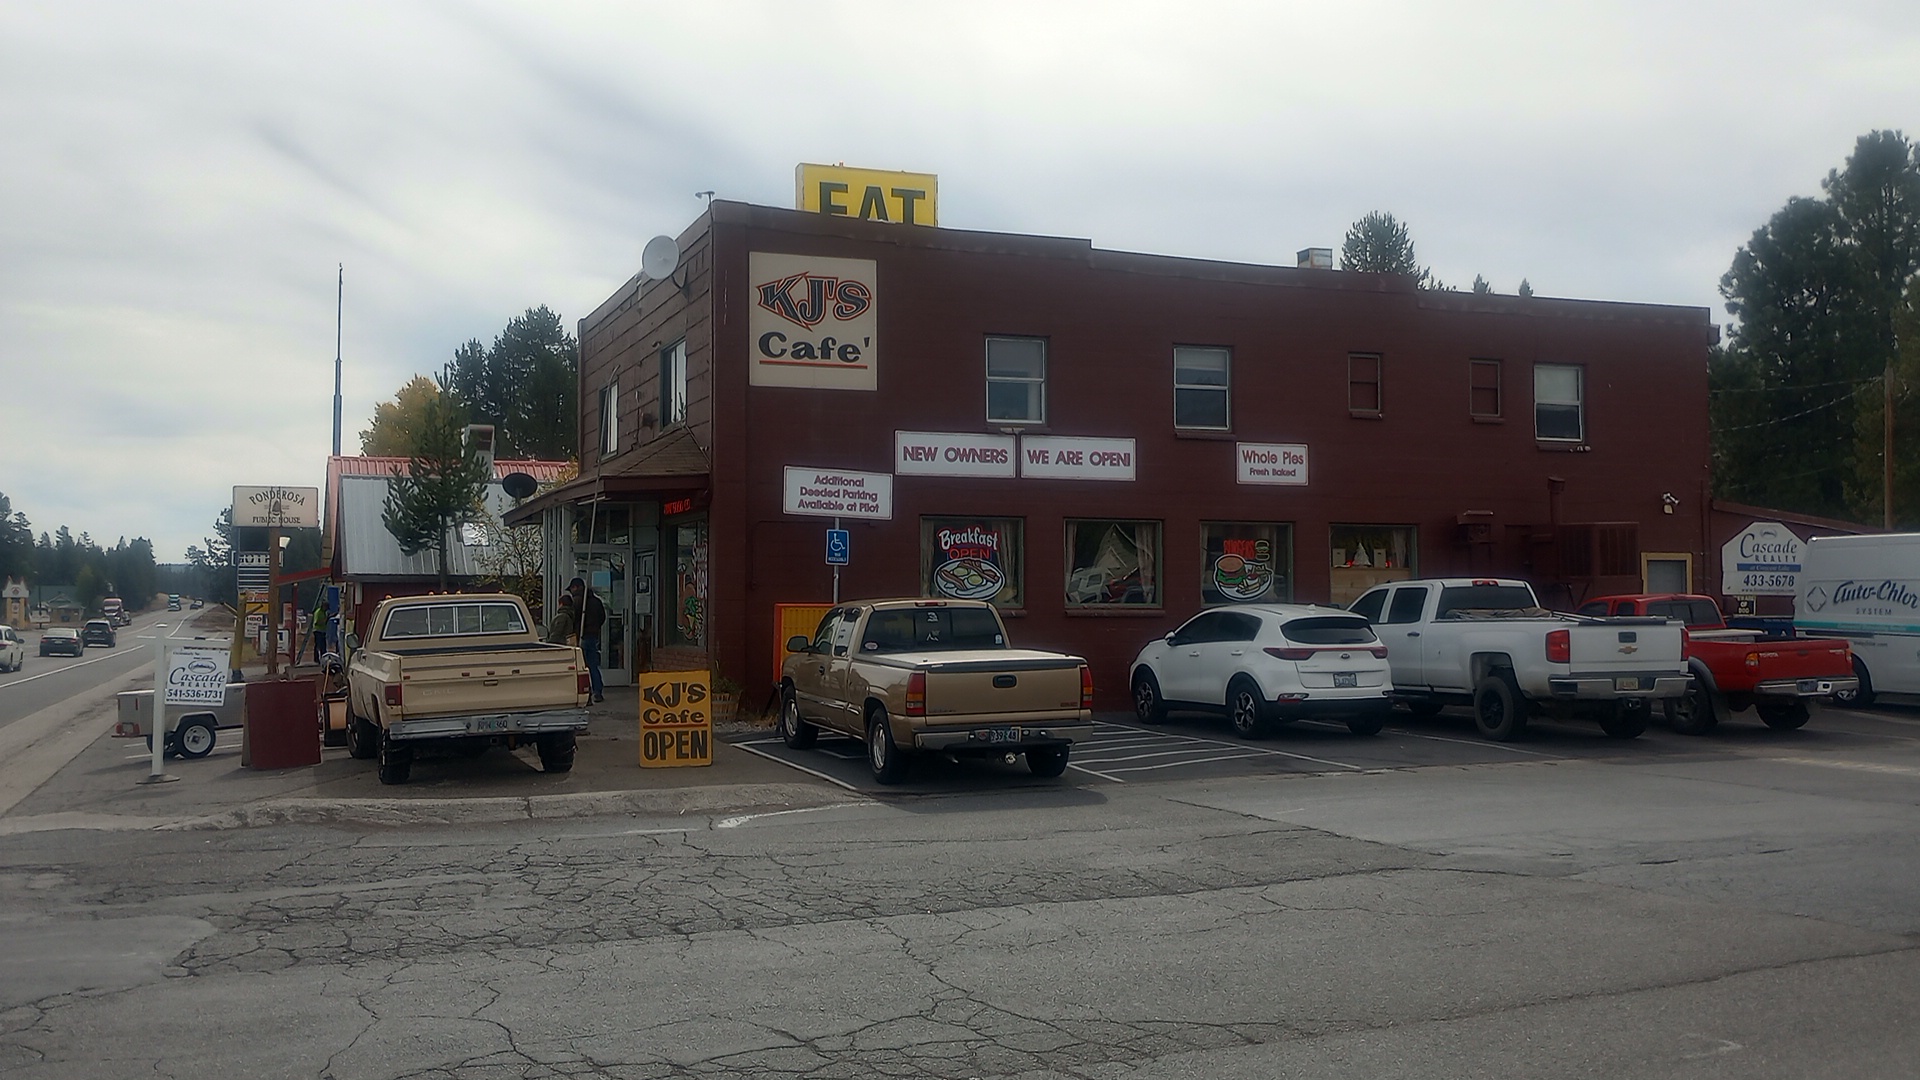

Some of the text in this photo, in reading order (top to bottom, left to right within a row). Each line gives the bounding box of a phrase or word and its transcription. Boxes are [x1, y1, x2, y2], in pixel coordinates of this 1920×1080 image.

[819, 181, 925, 225] EAT
[757, 271, 872, 331] KJ'S
[903, 446, 1008, 464] NEW OWNERS
[1027, 449, 1049, 464] WE
[1055, 450, 1083, 465] ARE
[1242, 450, 1304, 465] Whole Pies
[1249, 467, 1296, 477] Fresh Baked
[814, 475, 864, 487] Additional
[249, 490, 305, 506] PONDEROSA
[800, 486, 878, 502] Deeded Parking
[798, 499, 879, 513] Available at Pilot
[938, 526, 999, 551] Breakfast
[1740, 533, 1797, 558] Cascade
[949, 548, 991, 559] OPEN
[1755, 555, 1796, 563] REALTY
[1744, 574, 1794, 587] 433-5678
[1833, 579, 1918, 609] Auto-Chlor
[1855, 608, 1892, 616] SYSTEM
[169, 667, 225, 685] Cascade
[643, 681, 707, 709] KJ'S
[643, 708, 704, 724] Cafe
[643, 730, 707, 760] OPEN
